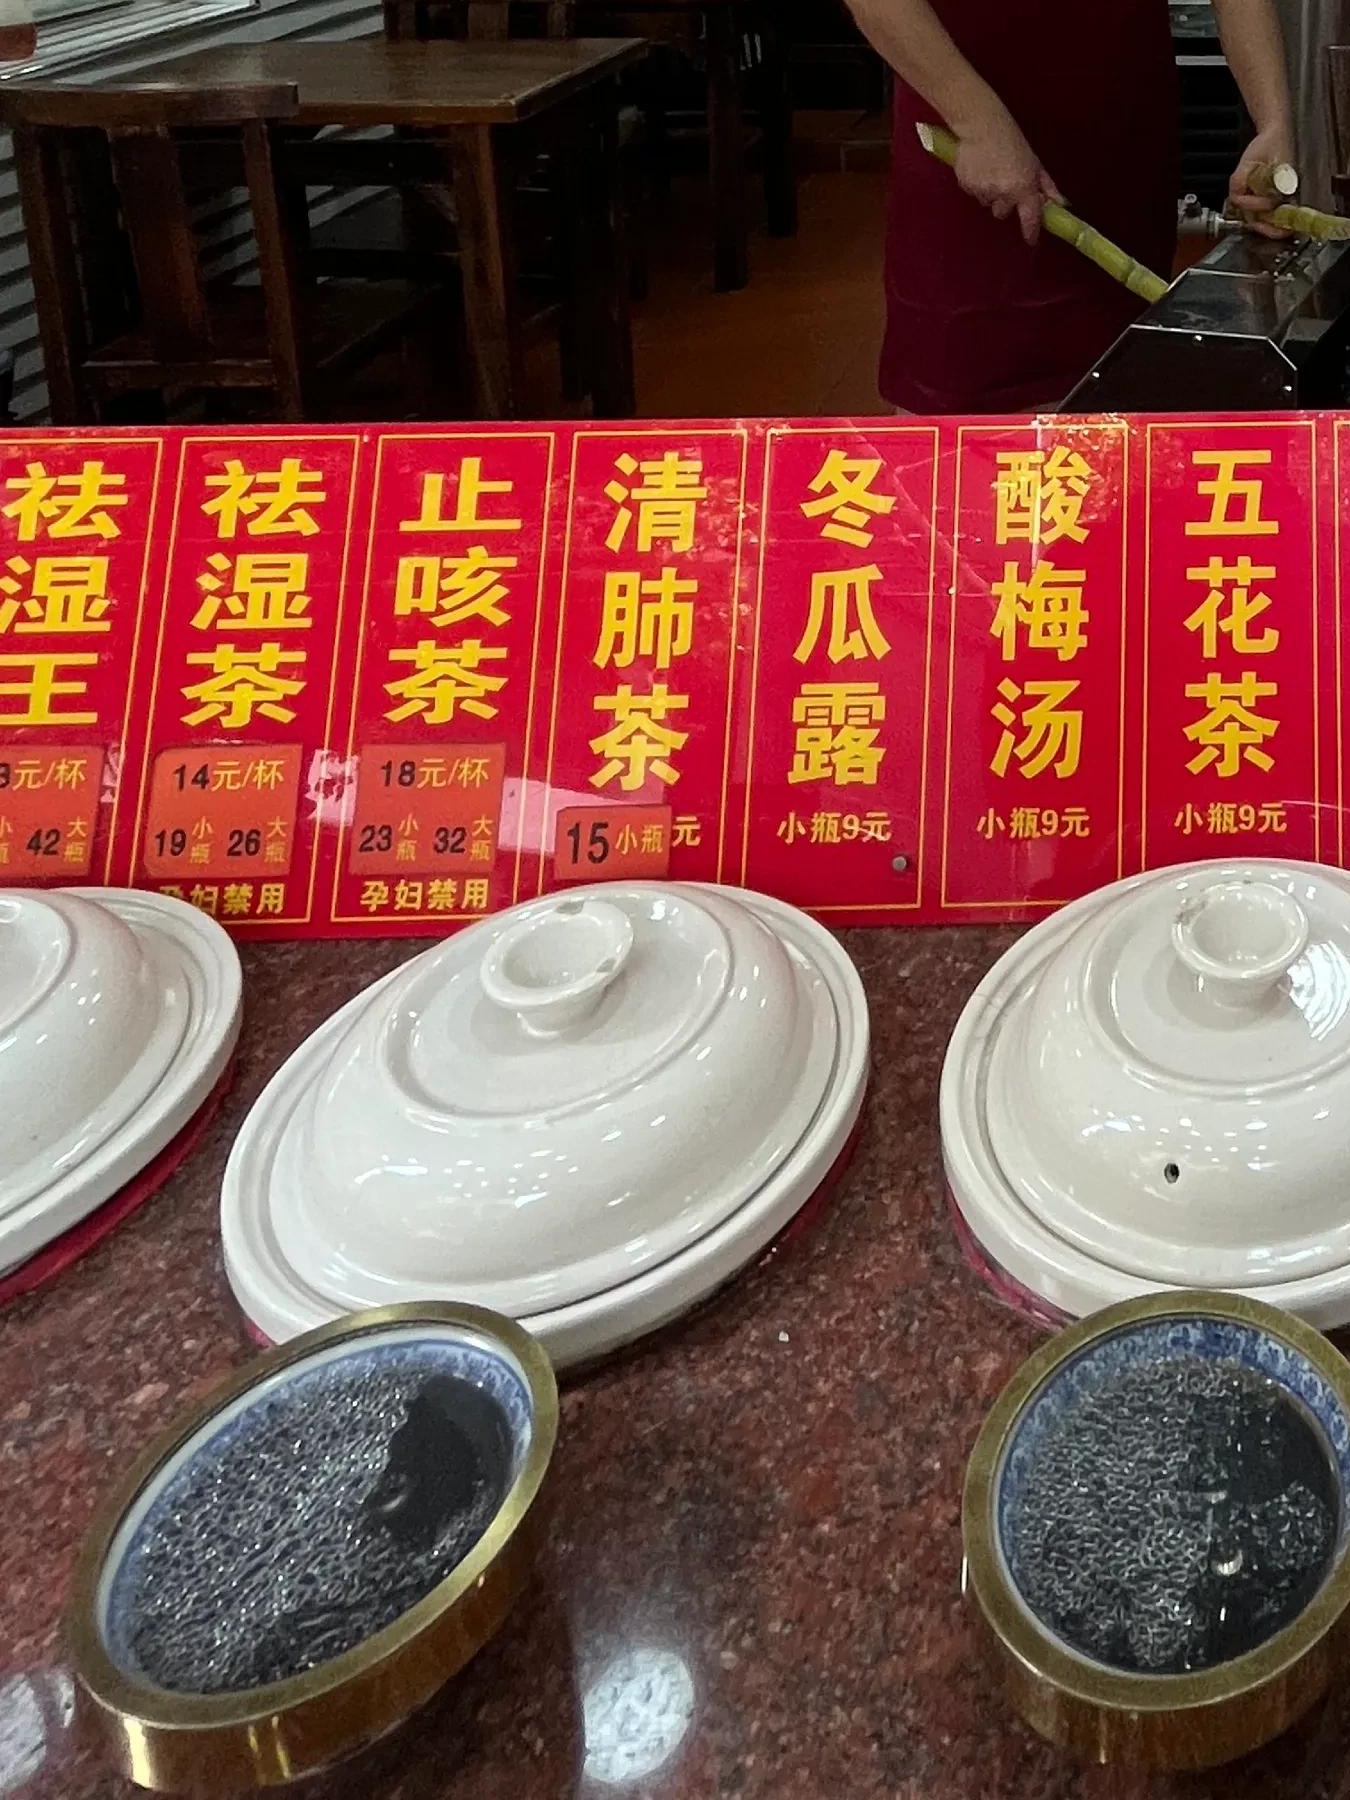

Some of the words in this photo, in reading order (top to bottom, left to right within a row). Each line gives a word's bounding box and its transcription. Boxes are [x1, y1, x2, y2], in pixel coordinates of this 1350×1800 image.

[0, 460, 129, 726] 祛湿王
[180, 457, 327, 728] 祛湿茶
[384, 457, 522, 725] 止咳茶
[989, 445, 1093, 780] 酸梅汤
[1184, 449, 1281, 777] 五花茶
[589, 451, 708, 792] 清肺茶
[787, 449, 897, 786] 冬瓜露
[173, 759, 285, 792] 14元/杯
[380, 757, 491, 790] 18元/杯
[26, 828, 61, 856] 42
[63, 816, 88, 863] 大瓶
[154, 829, 187, 856] 19
[189, 816, 214, 864] 小瓶
[226, 829, 261, 856] 26
[263, 816, 288, 864] 大瓶
[358, 824, 394, 853] 23
[395, 813, 420, 861] 小瓶
[433, 826, 468, 854] 32
[469, 815, 493, 861] 大瓶
[776, 811, 892, 845] 小瓶9元
[976, 806, 1090, 839] 小瓶9元
[1174, 802, 1288, 835] 小瓶9元
[360, 878, 489, 913] 孕妇禁用
